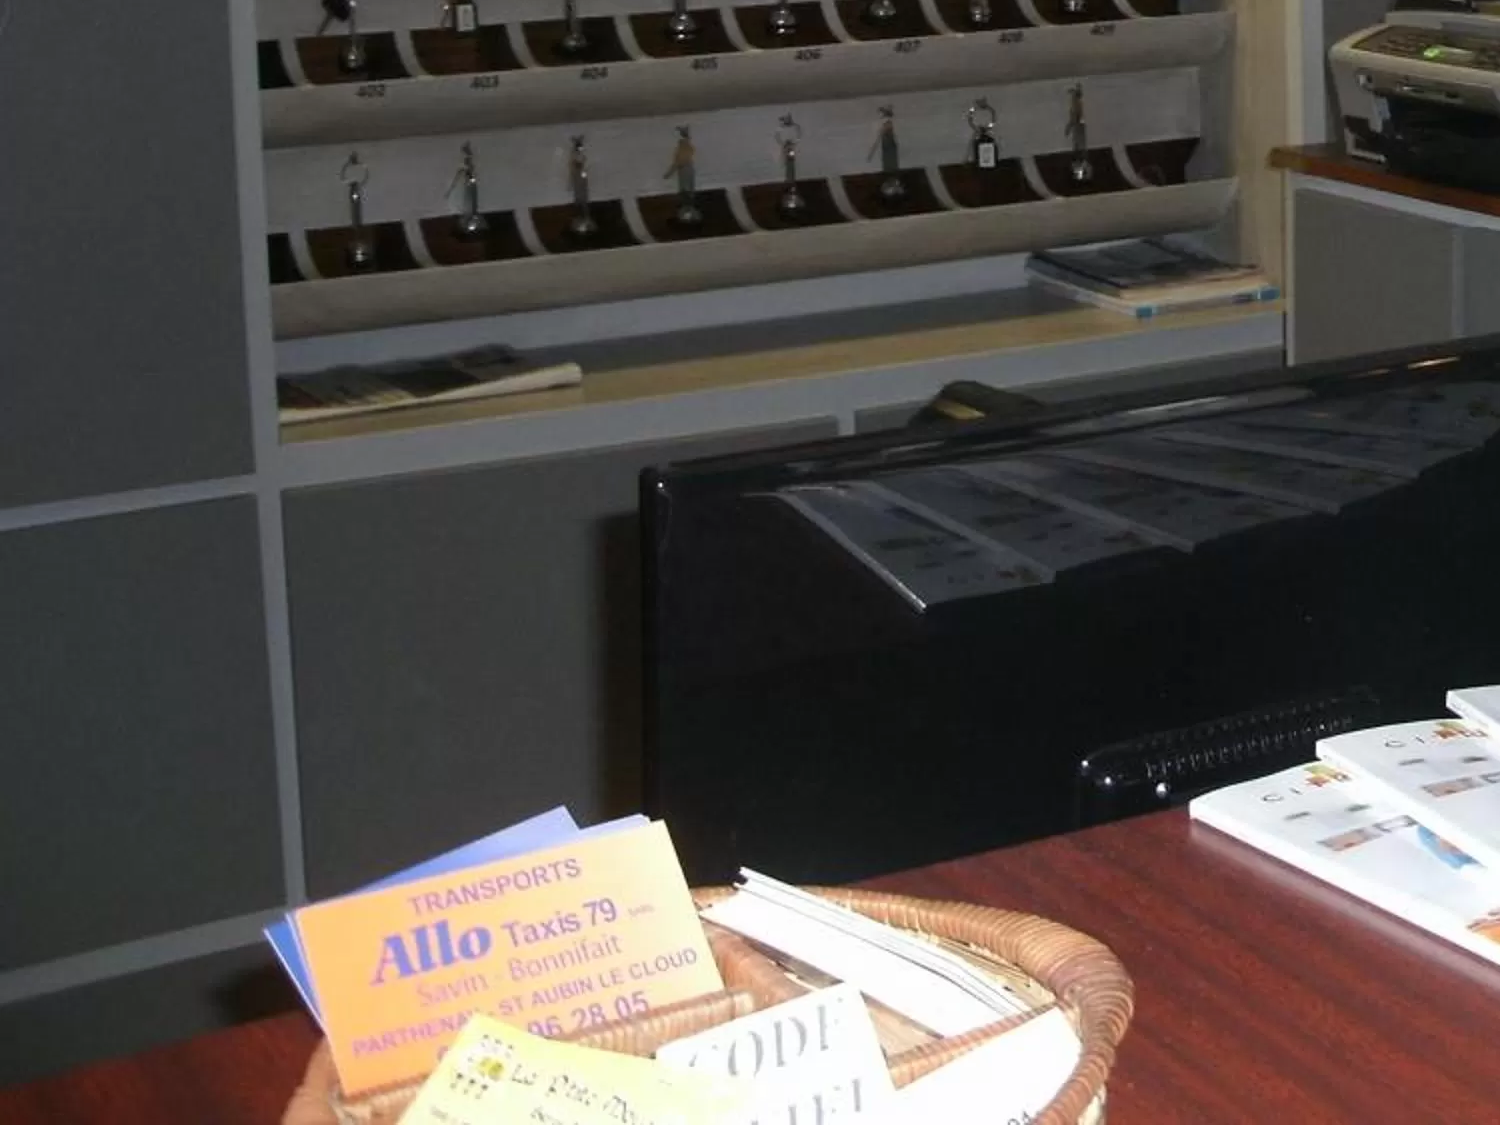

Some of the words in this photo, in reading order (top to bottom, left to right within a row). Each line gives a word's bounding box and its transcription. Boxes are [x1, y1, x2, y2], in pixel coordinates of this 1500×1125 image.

[408, 858, 583, 915] TRANSPORTS
[369, 919, 493, 987] Allo
[500, 909, 583, 948] Taxis
[582, 897, 618, 928] 79
[416, 971, 490, 1007] Savin
[507, 934, 624, 983] Bonnifait
[498, 995, 524, 1017] ST
[523, 975, 595, 1009] AUBIN
[599, 965, 626, 989] LE
[628, 946, 699, 982] CLOUD
[571, 1001, 607, 1032] 28
[614, 990, 651, 1020] 05
